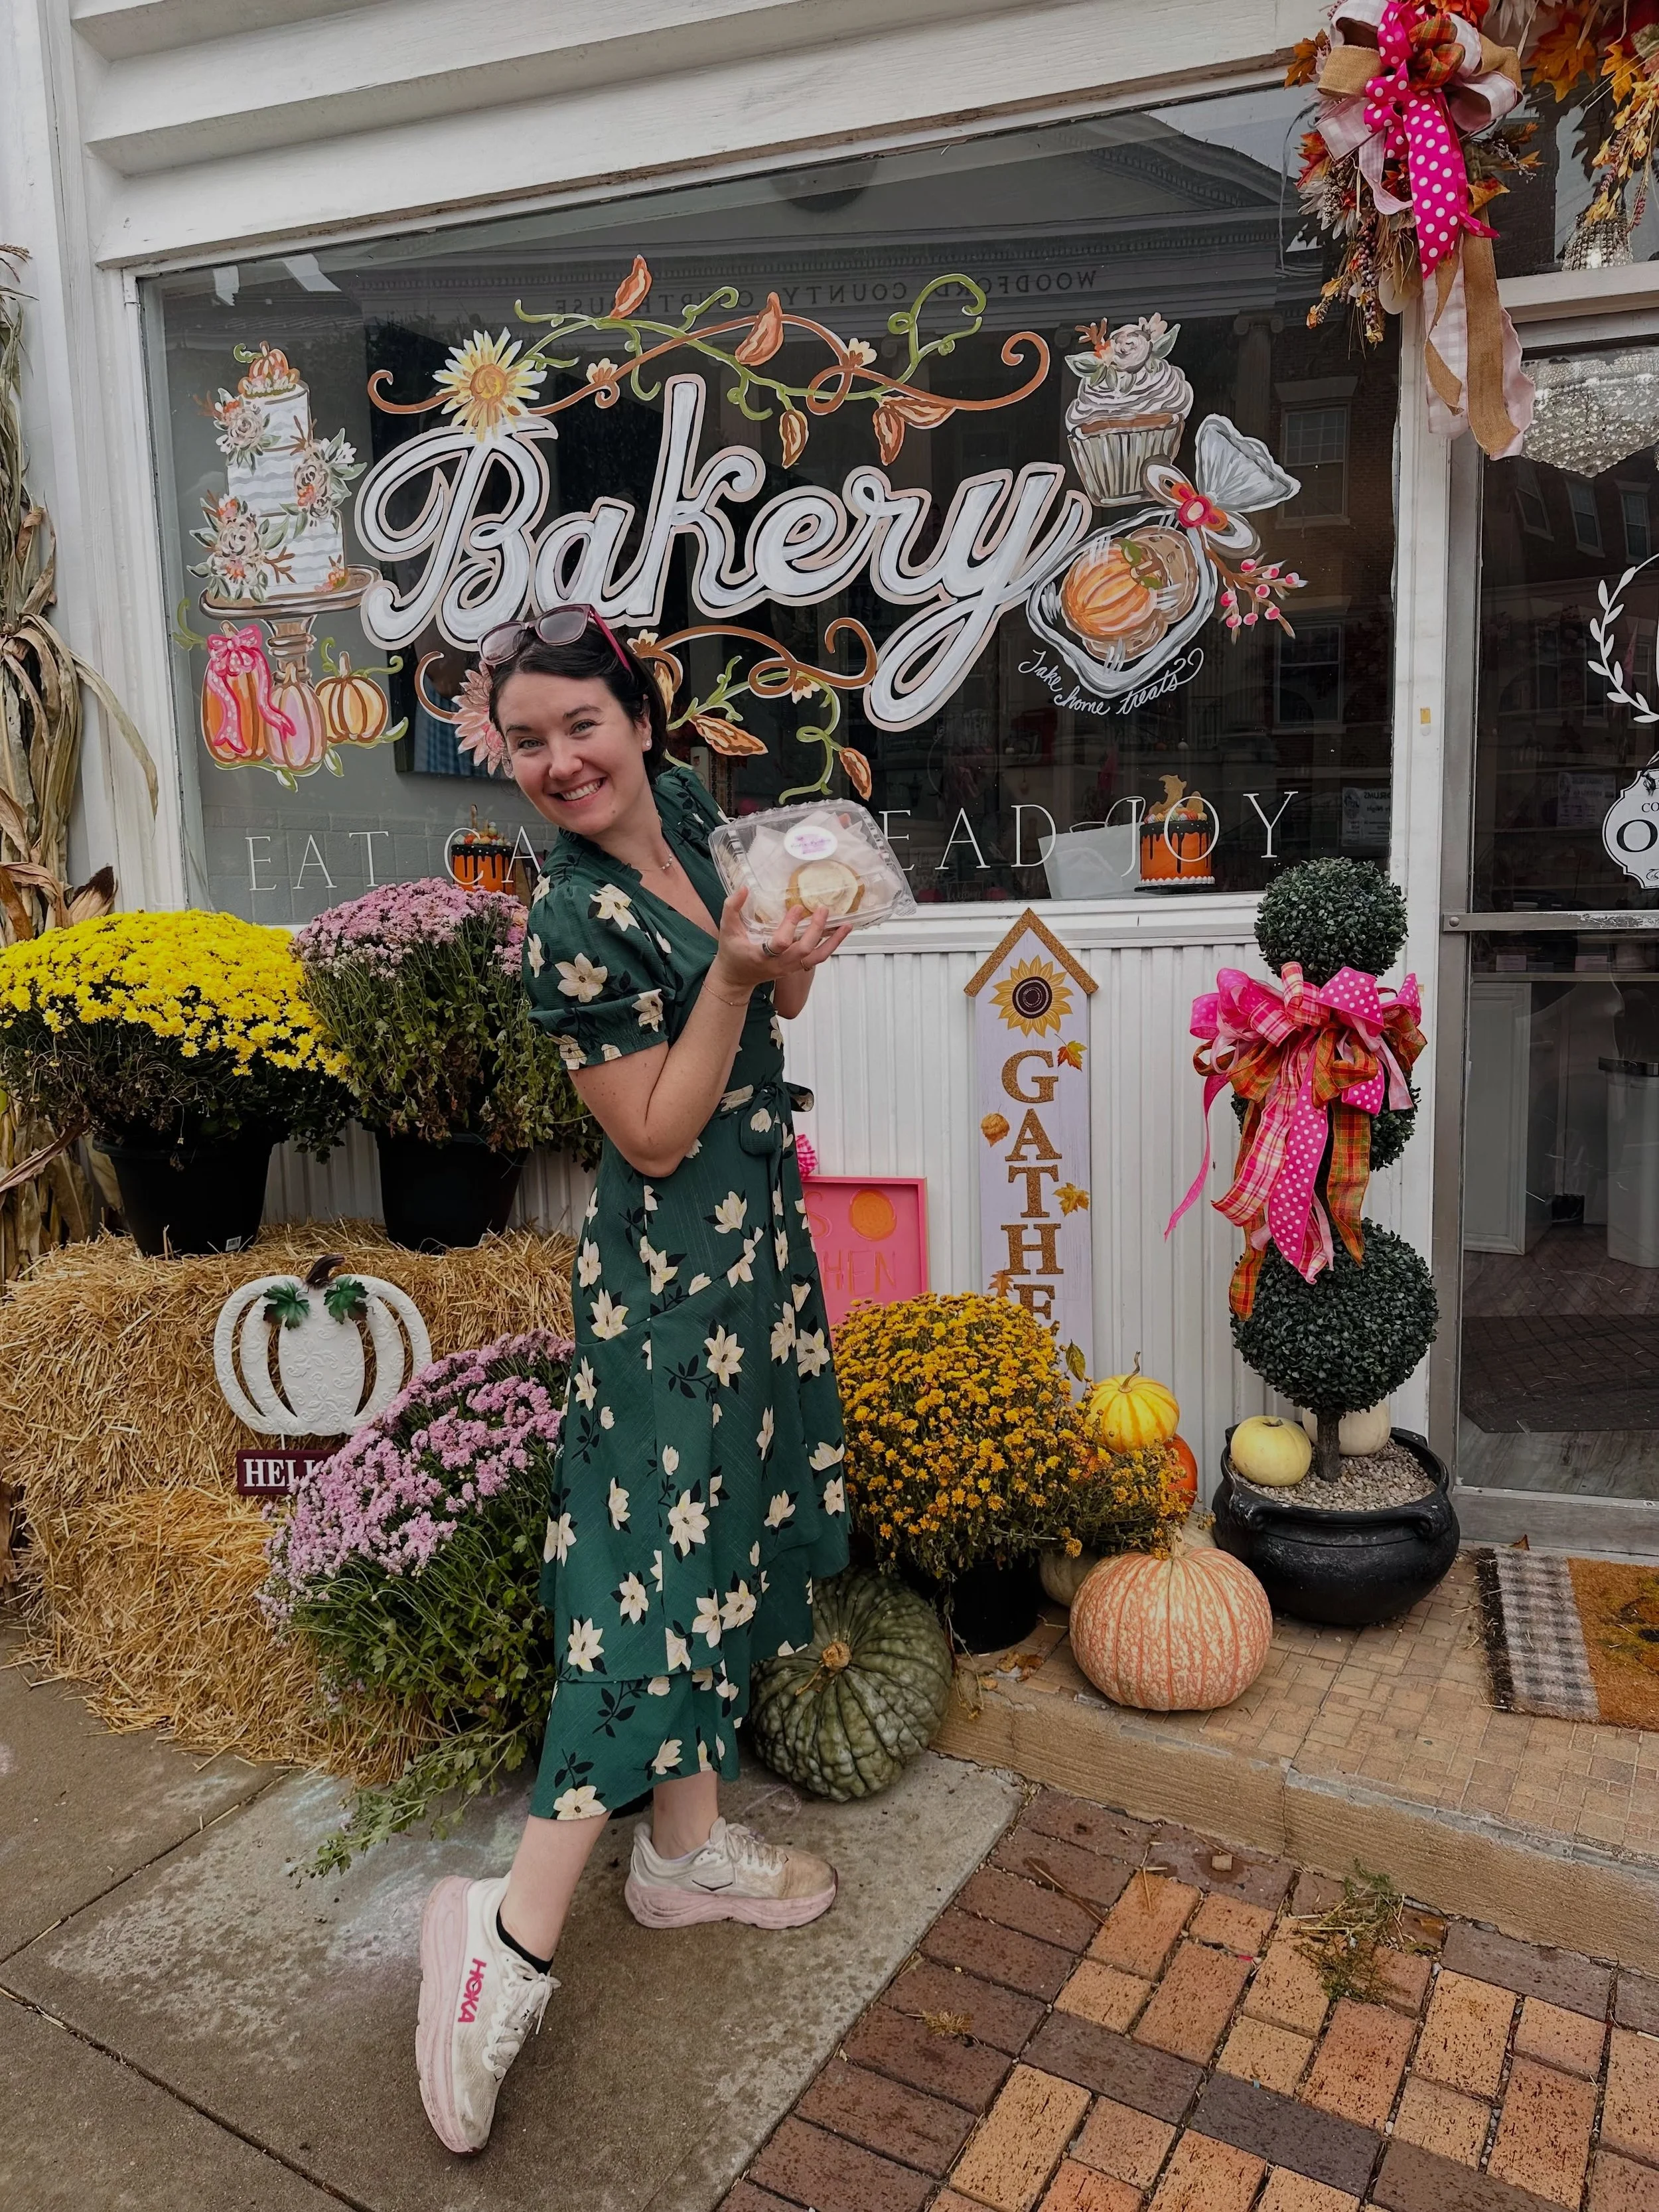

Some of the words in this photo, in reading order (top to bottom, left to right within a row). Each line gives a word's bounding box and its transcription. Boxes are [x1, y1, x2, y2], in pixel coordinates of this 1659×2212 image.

[354, 373, 1092, 733] Bakery
[1018, 649, 1063, 692] Take
[1054, 686, 1110, 715] home
[1116, 648, 1204, 715] treats
[245, 830, 390, 891] EAT
[444, 825, 542, 885] CA
[879, 804, 1056, 871] EAD
[1121, 791, 1299, 877] JOY
[1001, 1049, 1064, 1336] GATHE
[457, 1958, 487, 2023] HOKA
